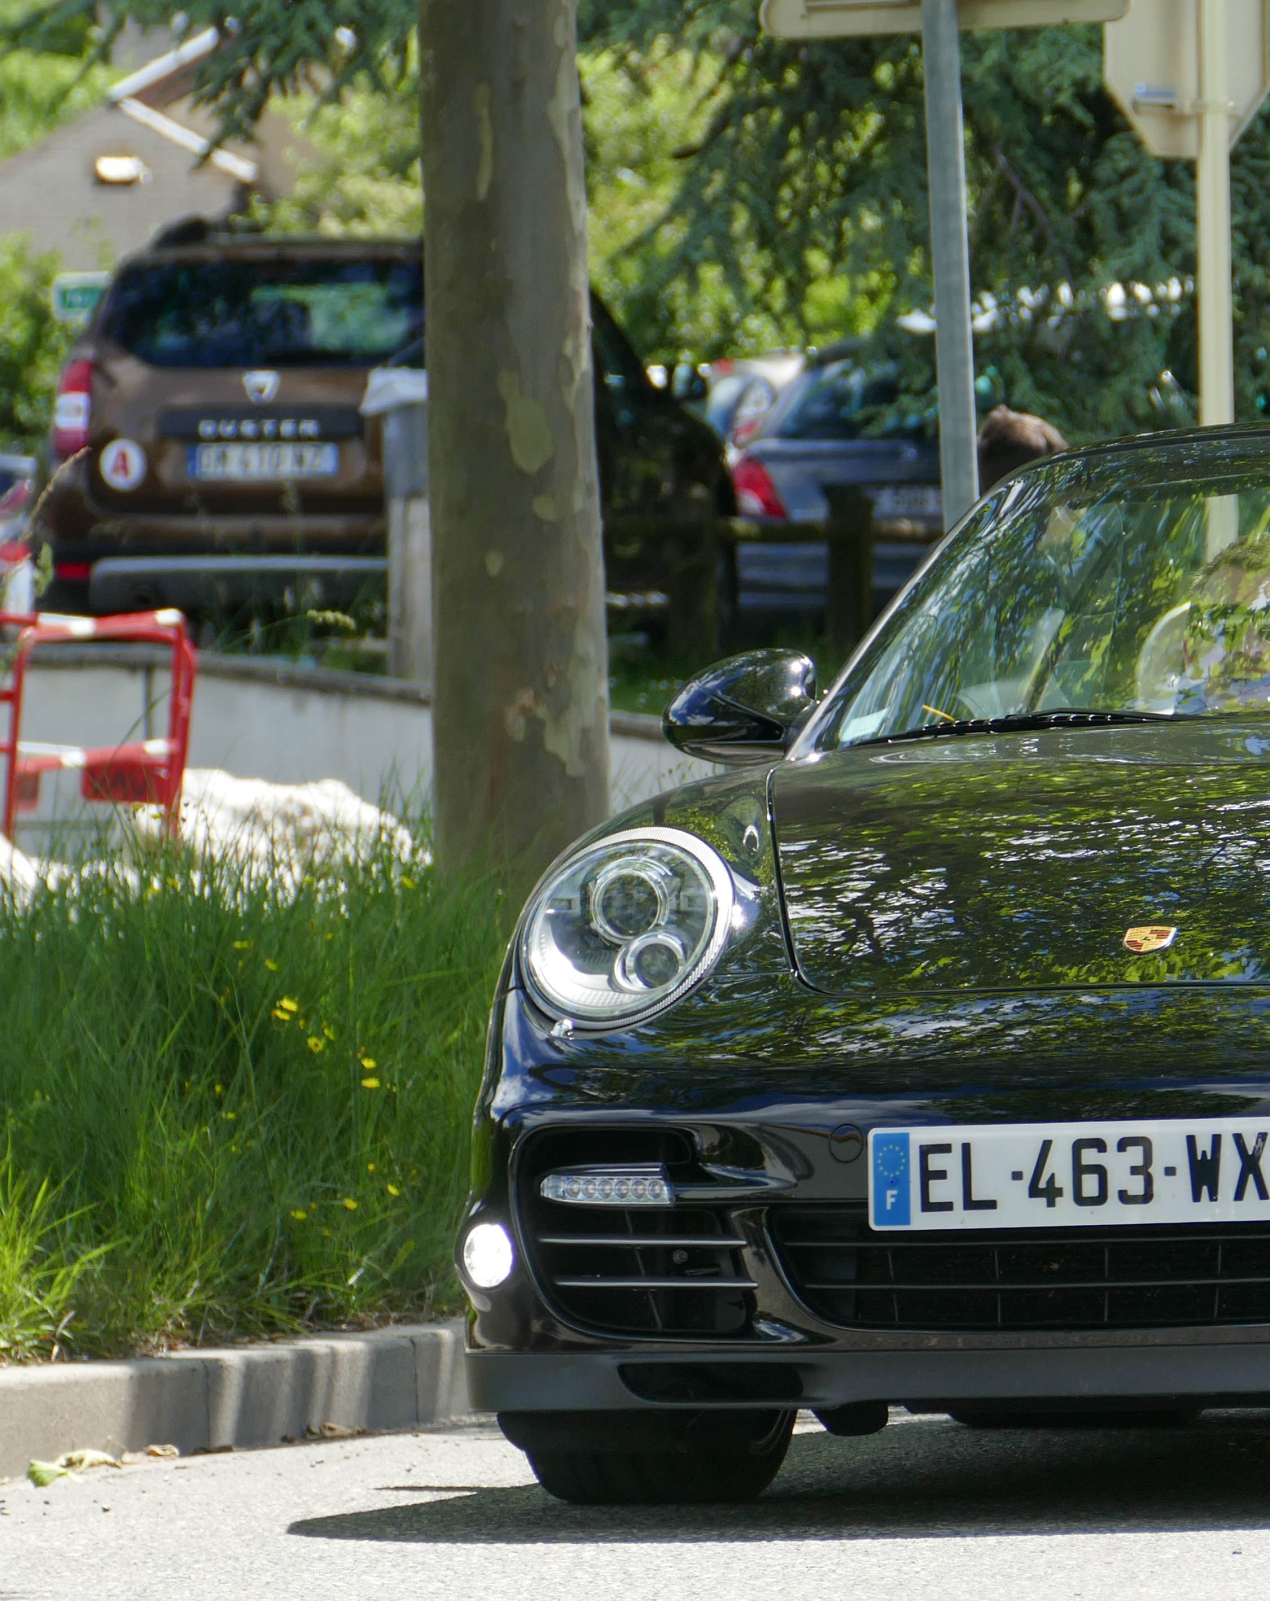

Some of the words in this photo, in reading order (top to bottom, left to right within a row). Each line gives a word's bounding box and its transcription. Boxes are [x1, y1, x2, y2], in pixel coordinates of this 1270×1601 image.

[198, 418, 320, 438] DUSTER
[111, 446, 131, 478] A
[919, 1132, 1270, 1213] EL-463-WX
[885, 1189, 898, 1210] F
